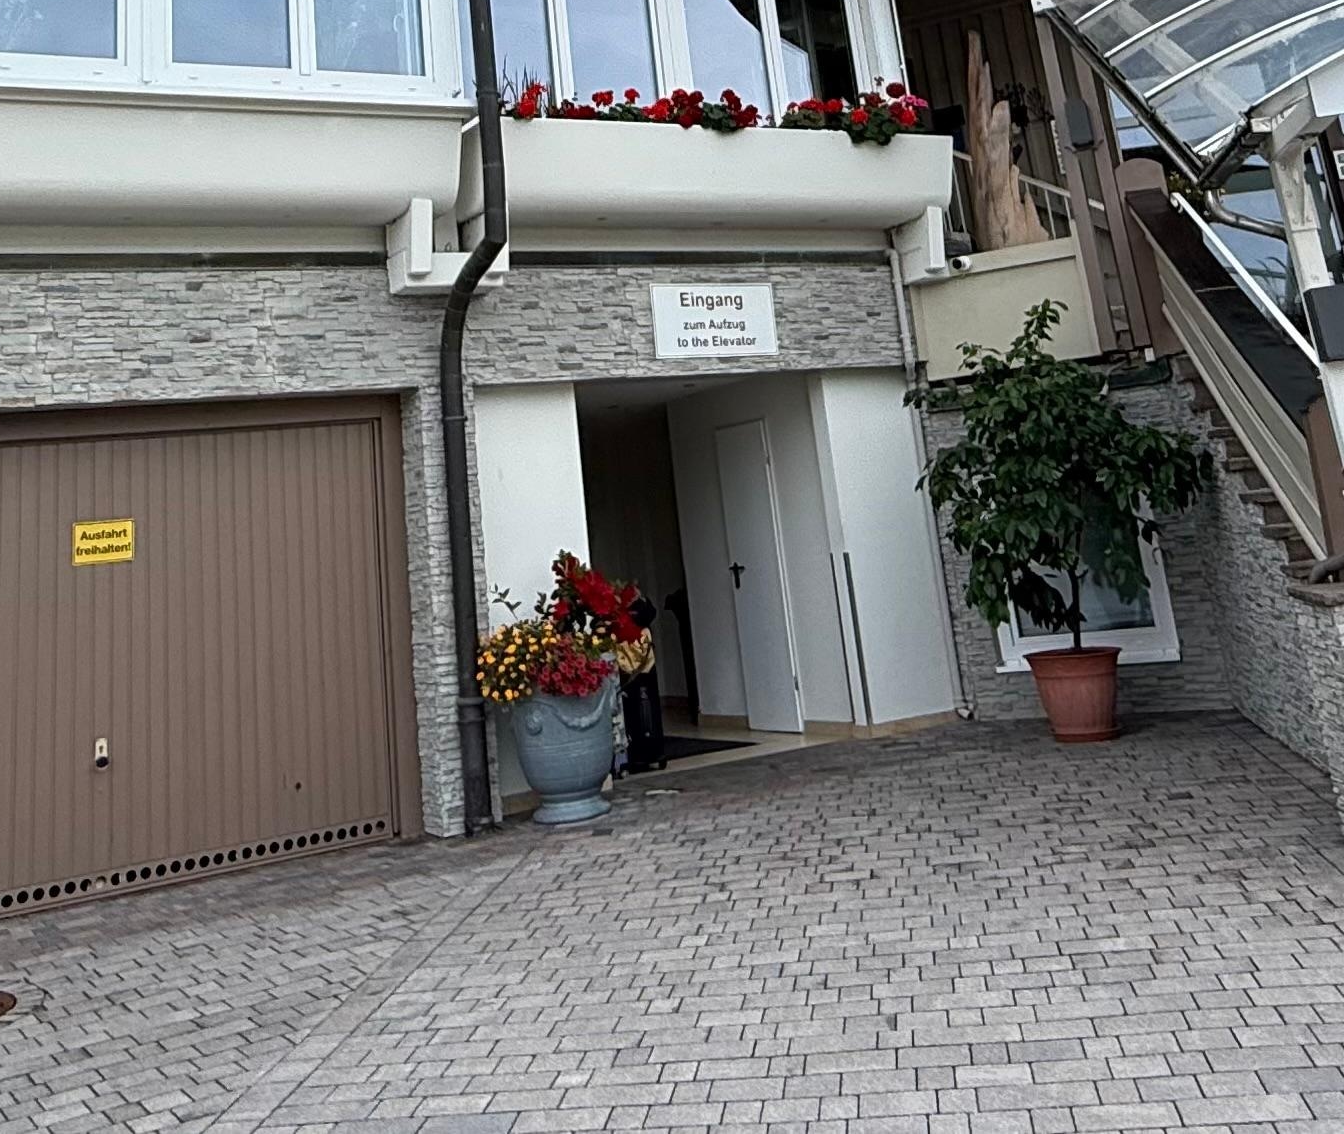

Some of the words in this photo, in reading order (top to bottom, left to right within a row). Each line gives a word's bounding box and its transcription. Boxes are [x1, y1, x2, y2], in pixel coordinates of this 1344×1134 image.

[679, 292, 744, 311] Eingang
[683, 321, 706, 330] zum
[708, 318, 746, 331] Aufzug
[677, 337, 689, 347] to
[692, 336, 709, 347] the
[712, 335, 757, 347] Elevator
[80, 529, 128, 541] Ausfahrt
[76, 542, 132, 556] freihalten!
